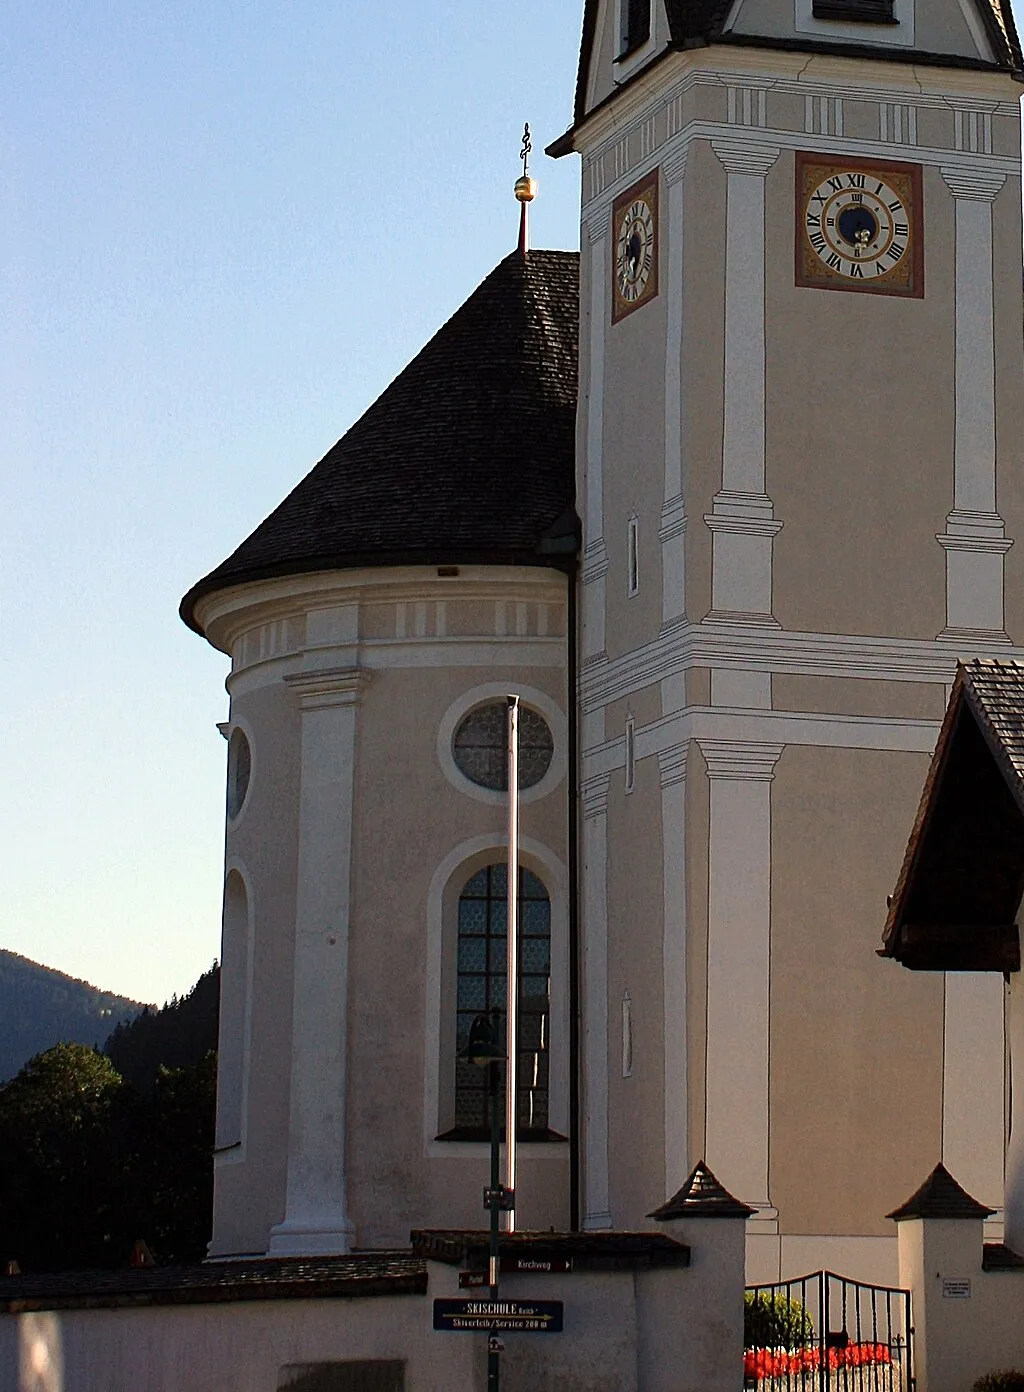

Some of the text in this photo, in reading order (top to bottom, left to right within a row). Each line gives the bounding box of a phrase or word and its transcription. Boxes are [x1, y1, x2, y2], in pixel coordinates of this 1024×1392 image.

[827, 176, 843, 193] XI
[847, 174, 865, 189] XII
[875, 183, 884, 195] I
[811, 190, 828, 207] X
[888, 200, 903, 213] II
[807, 213, 820, 227] IX
[895, 223, 908, 236] III
[809, 231, 827, 255] VIII
[886, 242, 904, 261] IIII
[826, 252, 841, 272] VII
[876, 261, 887, 275] V
[850, 263, 864, 278] VI
[518, 1259, 551, 1270] Kirchweg
[467, 1302, 517, 1315] SKISCHULE
[525, 1319, 539, 1328] 200
